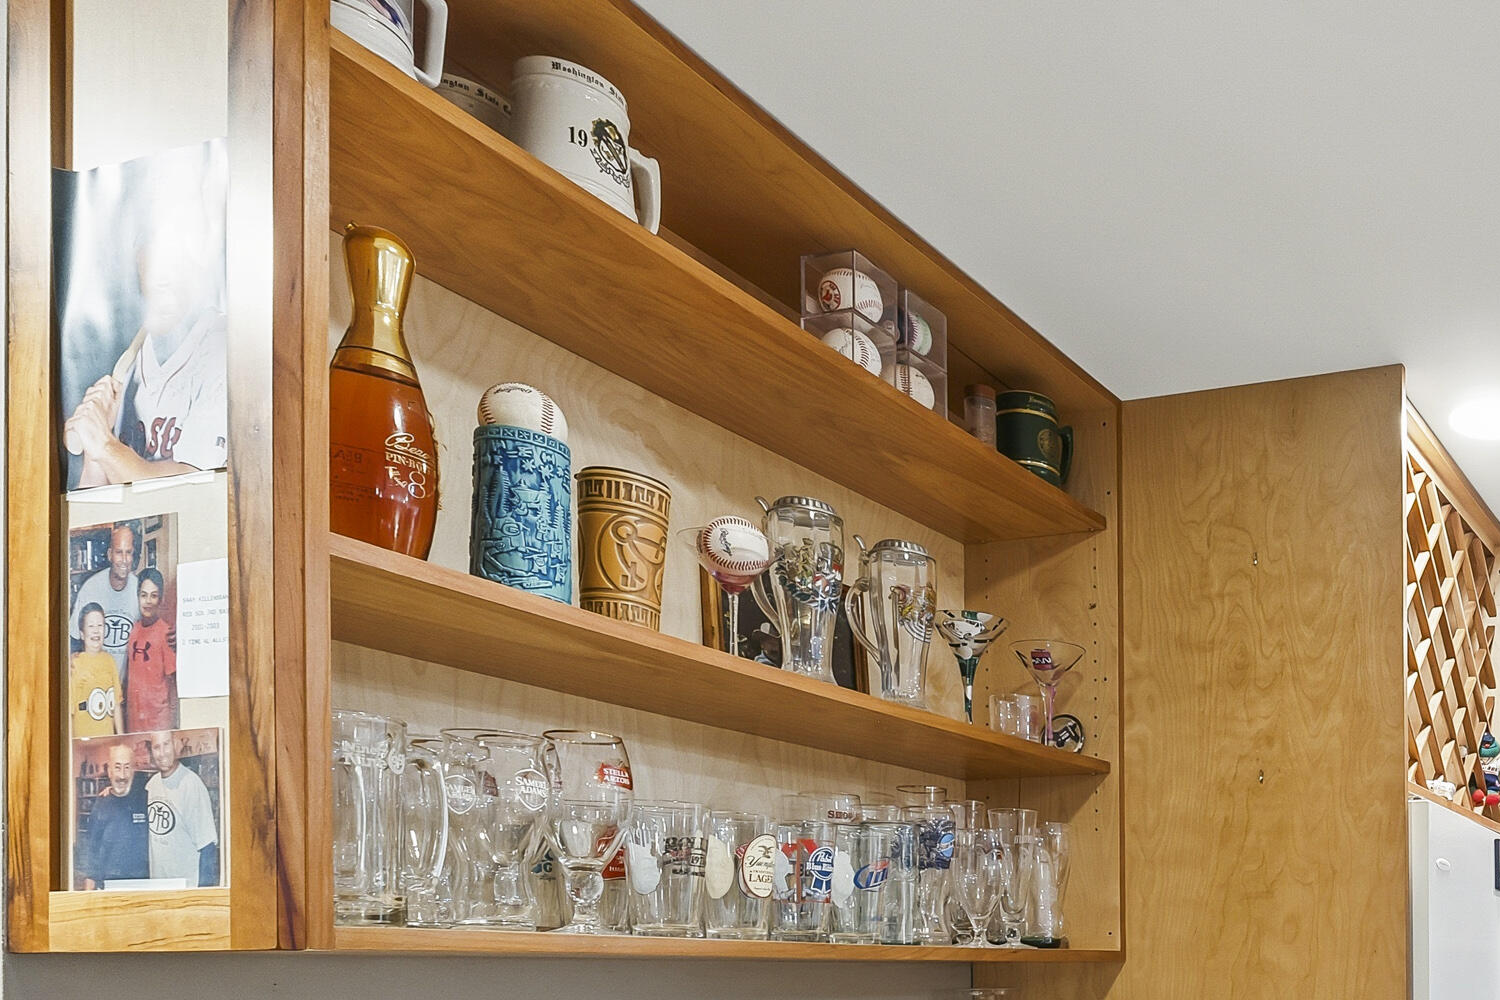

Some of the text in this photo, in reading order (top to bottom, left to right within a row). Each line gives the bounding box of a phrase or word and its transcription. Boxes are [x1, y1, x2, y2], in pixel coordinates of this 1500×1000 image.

[568, 126, 588, 147] 19
[603, 767, 630, 779] STELLA
[515, 777, 548, 790] SAMUEL
[748, 873, 773, 884] LAGE
